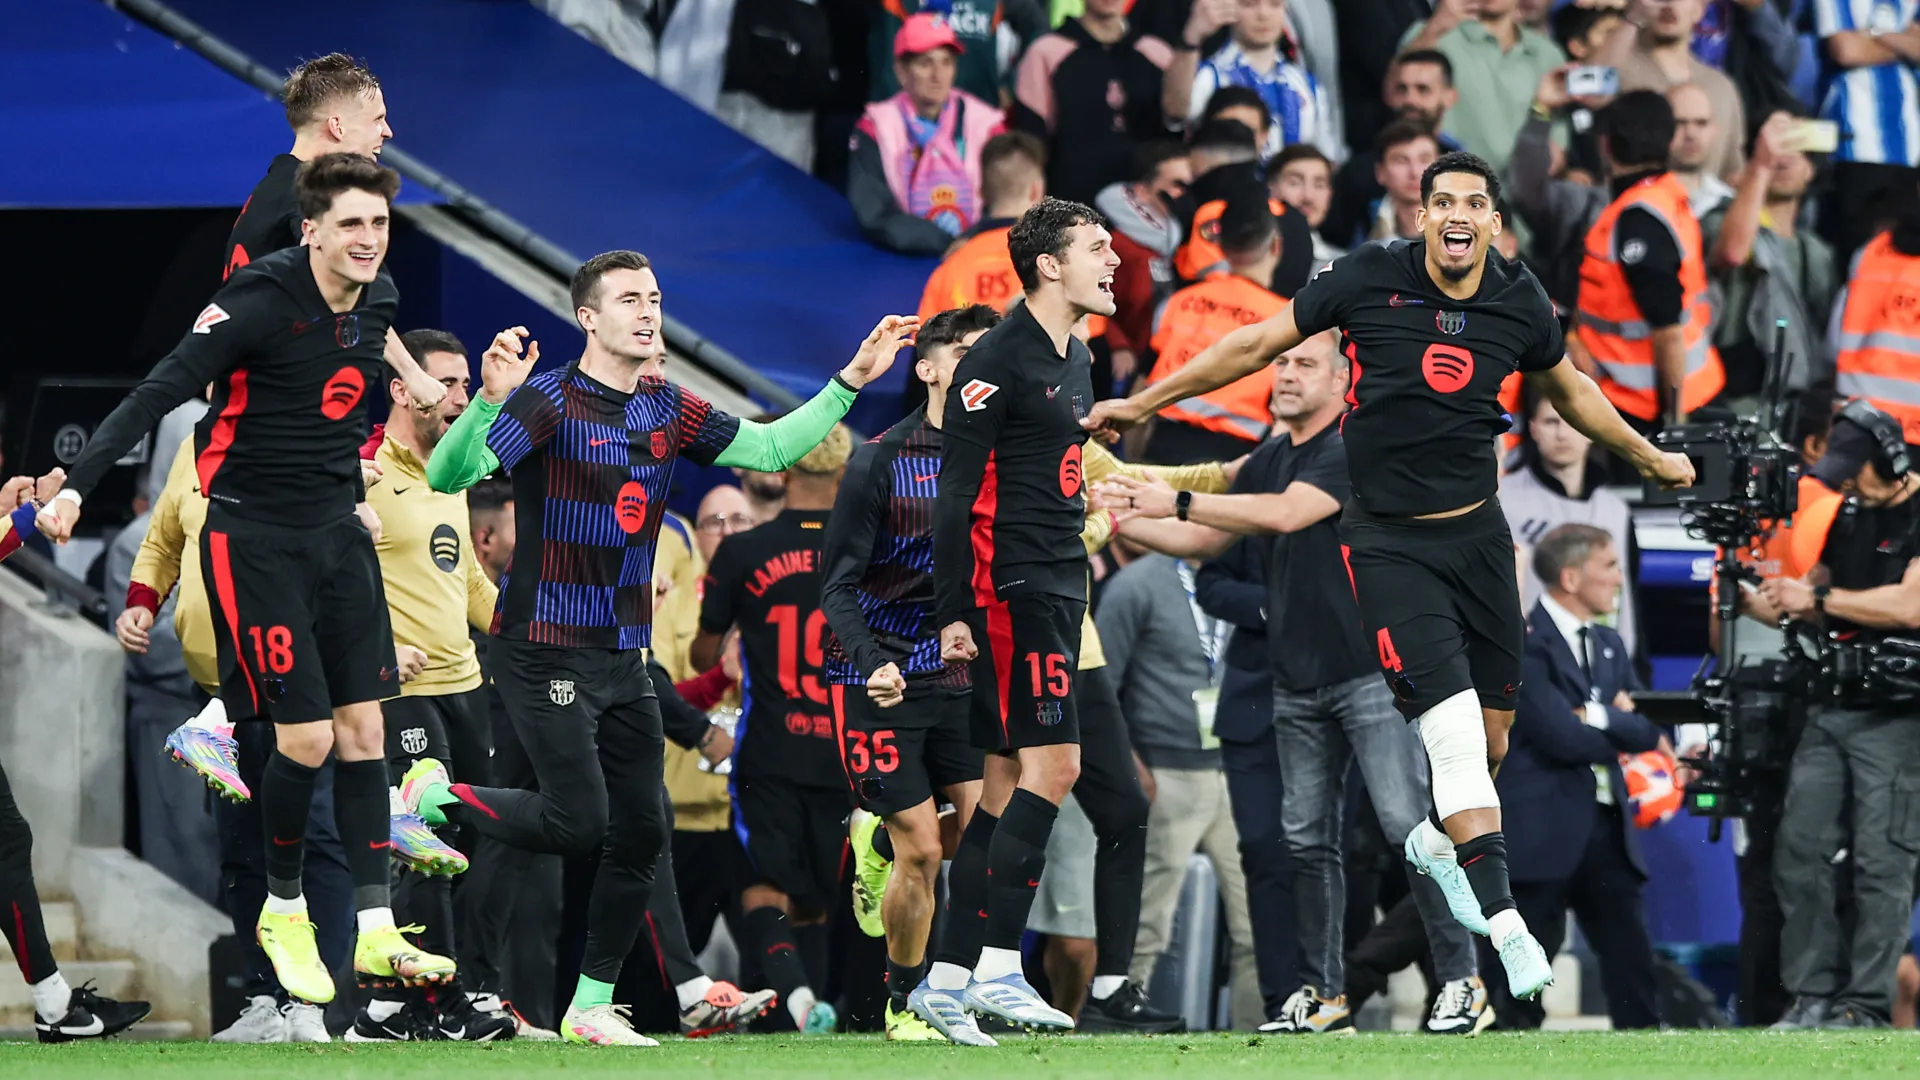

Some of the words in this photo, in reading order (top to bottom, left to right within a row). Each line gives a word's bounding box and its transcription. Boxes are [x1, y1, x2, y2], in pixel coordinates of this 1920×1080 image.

[744, 549, 814, 598] LAMINE
[248, 624, 294, 674] 18
[1377, 627, 1403, 673] 4
[1024, 652, 1069, 697] 15
[846, 729, 900, 774] 35
